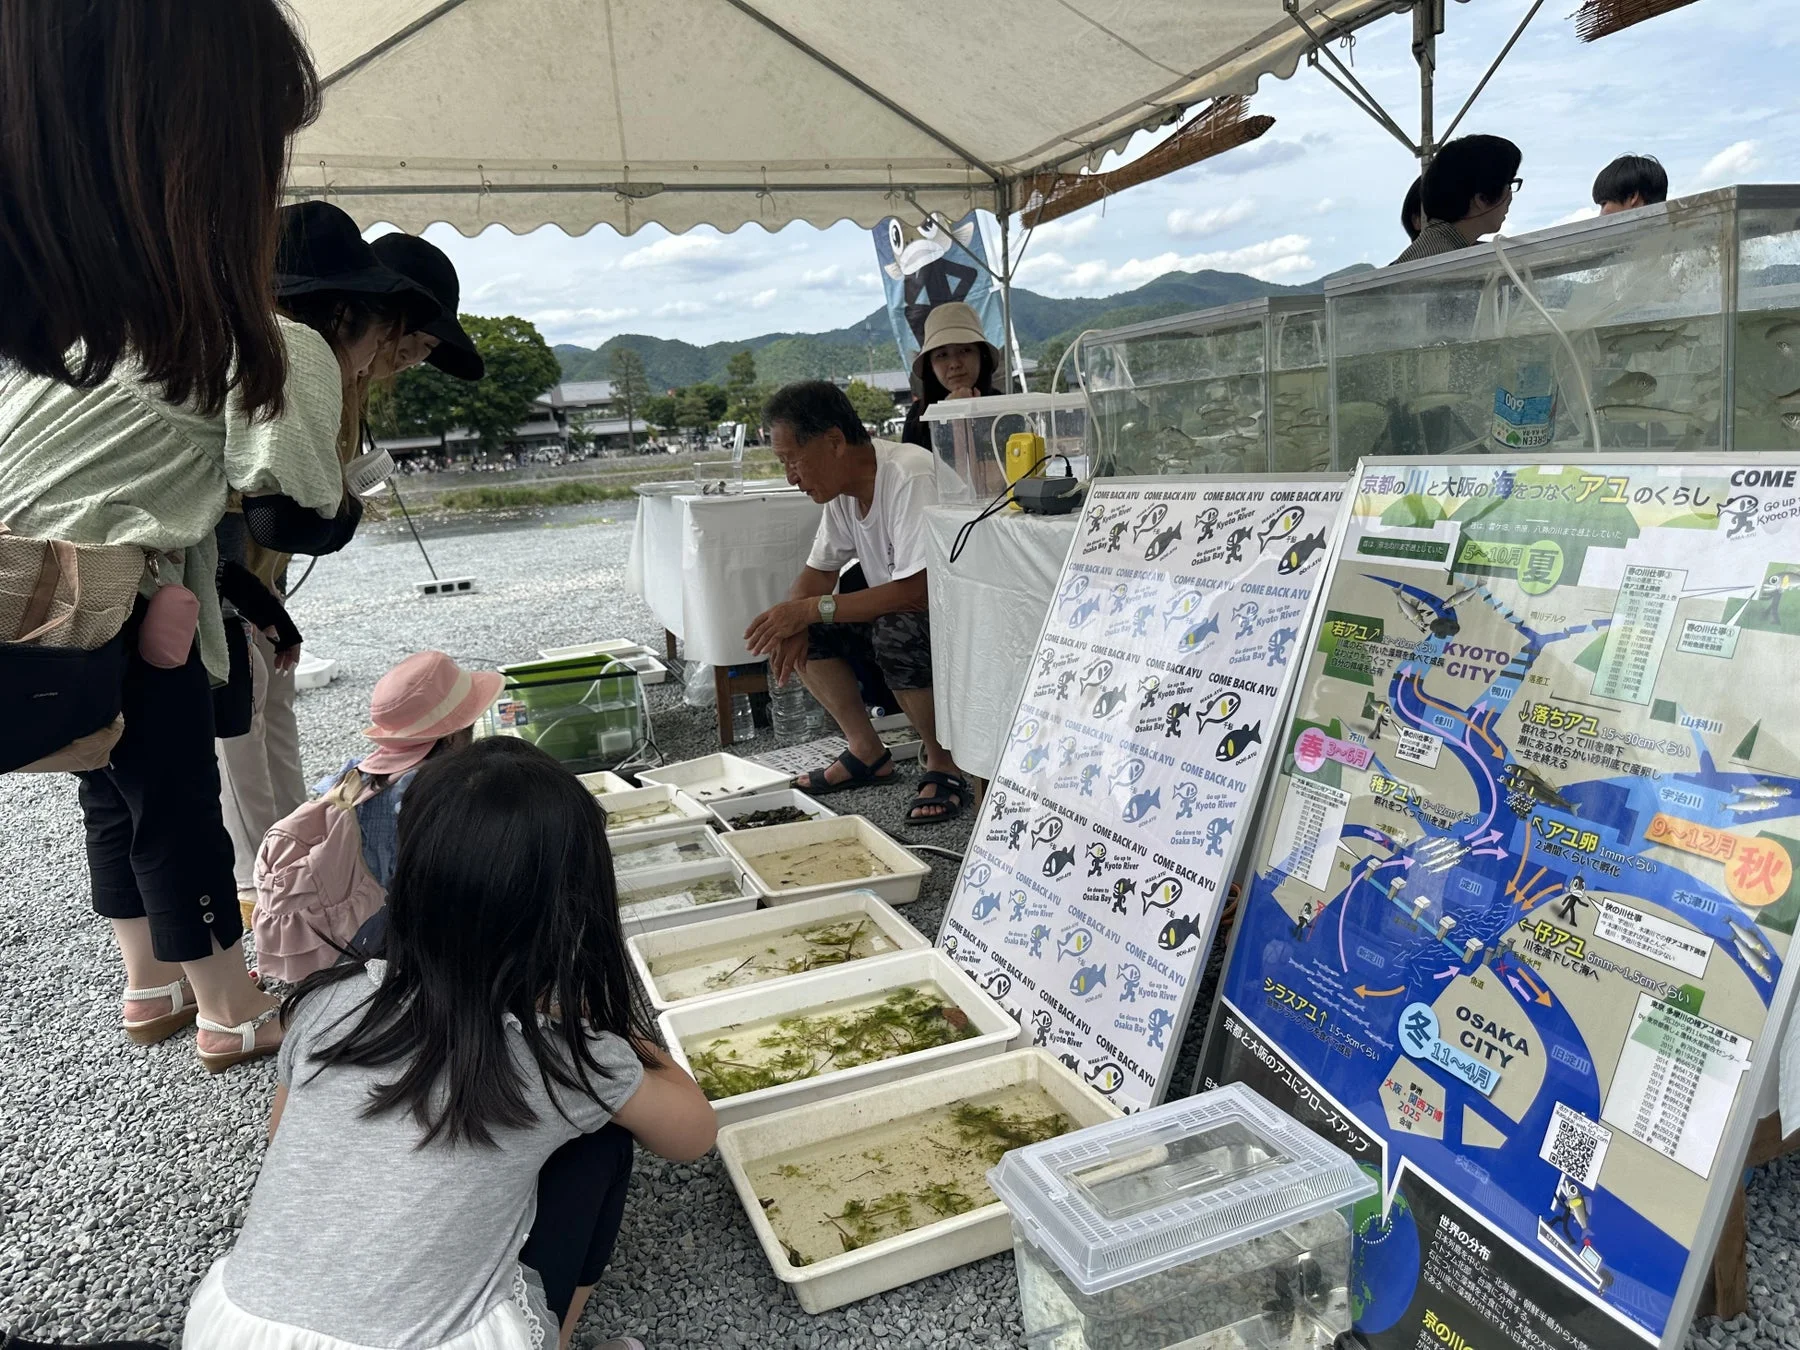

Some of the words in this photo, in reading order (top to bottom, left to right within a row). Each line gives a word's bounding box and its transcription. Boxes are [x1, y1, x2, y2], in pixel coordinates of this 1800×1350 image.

[1522, 435, 1547, 446] GREEN
[1361, 470, 1711, 507] 京都の川と大阪の海をつなぐアユのくらし
[1730, 470, 1798, 488] COME
[1203, 491, 1224, 501] COME
[1225, 491, 1246, 501] BACK
[1246, 492, 1264, 501] AYU
[1270, 491, 1295, 501] COME
[1296, 491, 1321, 501] BACK
[1322, 491, 1344, 501] AYU
[1764, 501, 1779, 512] Go
[1782, 497, 1796, 508] up
[1757, 512, 1788, 526] Kyoto
[1522, 548, 1559, 585] 夏
[1240, 583, 1265, 595] COME
[1265, 585, 1290, 599] BACK
[1290, 588, 1311, 600] AYU
[1146, 658, 1166, 670] COME
[1166, 662, 1187, 675] BACK
[1185, 667, 1203, 679] AYU
[1442, 642, 1510, 666] KYOTO
[1208, 672, 1233, 686] COME
[1233, 678, 1258, 693] BACK
[1257, 684, 1278, 697] AYU
[1446, 662, 1496, 684] CITY
[1491, 686, 1513, 699] 鴨川
[1531, 704, 1600, 737] 落ちアユ
[1681, 716, 1723, 734] 山科川
[1301, 734, 1325, 767] 春
[1520, 723, 1625, 756] 群れをつくって川を降下
[1515, 749, 1569, 770] 一生を終える
[1517, 735, 1662, 782] 瀬にある軟らかい砂利底で産卵し
[1181, 761, 1205, 777] COME
[1204, 769, 1228, 787] BACK
[1227, 778, 1247, 793] AYU
[1370, 775, 1409, 803] 稚アユ
[1195, 802, 1216, 812] Kyoto
[1218, 801, 1238, 809] River
[1660, 788, 1702, 809] 宇治川
[1092, 823, 1112, 840] COME
[1112, 832, 1133, 850] BACK
[1131, 842, 1148, 857] AYU
[1170, 837, 1191, 845] Osaka
[1191, 837, 1205, 847] Bay
[1544, 821, 1599, 853] アユ卵
[1152, 853, 1176, 871] COME
[1175, 864, 1199, 884] BACK
[1197, 876, 1217, 892] AYU
[1535, 839, 1621, 879] 2週間くらいで孵化
[1599, 847, 1657, 874] 1mmくらい
[1650, 818, 1736, 859] 9〜12月
[1733, 846, 1785, 897] 秋
[1605, 902, 1643, 923] 秋の川仕事
[1673, 890, 1717, 914] 木津川
[1534, 921, 1586, 959] 仔アユ
[1125, 941, 1147, 962] COME
[1146, 955, 1170, 977] BACK
[1168, 969, 1187, 988] AYU
[1523, 938, 1600, 982] 川を流下して海へ
[1138, 986, 1158, 998] Kyoto
[1159, 990, 1178, 1002] River
[1264, 977, 1318, 1022] シラスアユ
[1040, 989, 1058, 1010] COME
[1057, 1003, 1077, 1023] BACK
[1075, 1017, 1092, 1036] AYU
[1114, 1018, 1133, 1032] Osaka
[1134, 1023, 1147, 1036] Bay
[1455, 1006, 1530, 1057] OSAKA
[1096, 1034, 1118, 1057] COME
[1117, 1050, 1139, 1075] BACK
[1137, 1067, 1157, 1088] AYU
[1404, 1010, 1432, 1050] 冬
[1431, 1042, 1492, 1090] 11〜4月
[1460, 1030, 1515, 1070] CITY
[1222, 1015, 1371, 1152] 京都と大阪のアユにクローズアップ
[1384, 1078, 1444, 1123] 大阪・関西万博
[1397, 1101, 1422, 1123] 2025
[1438, 1214, 1492, 1261] 世界の分布
